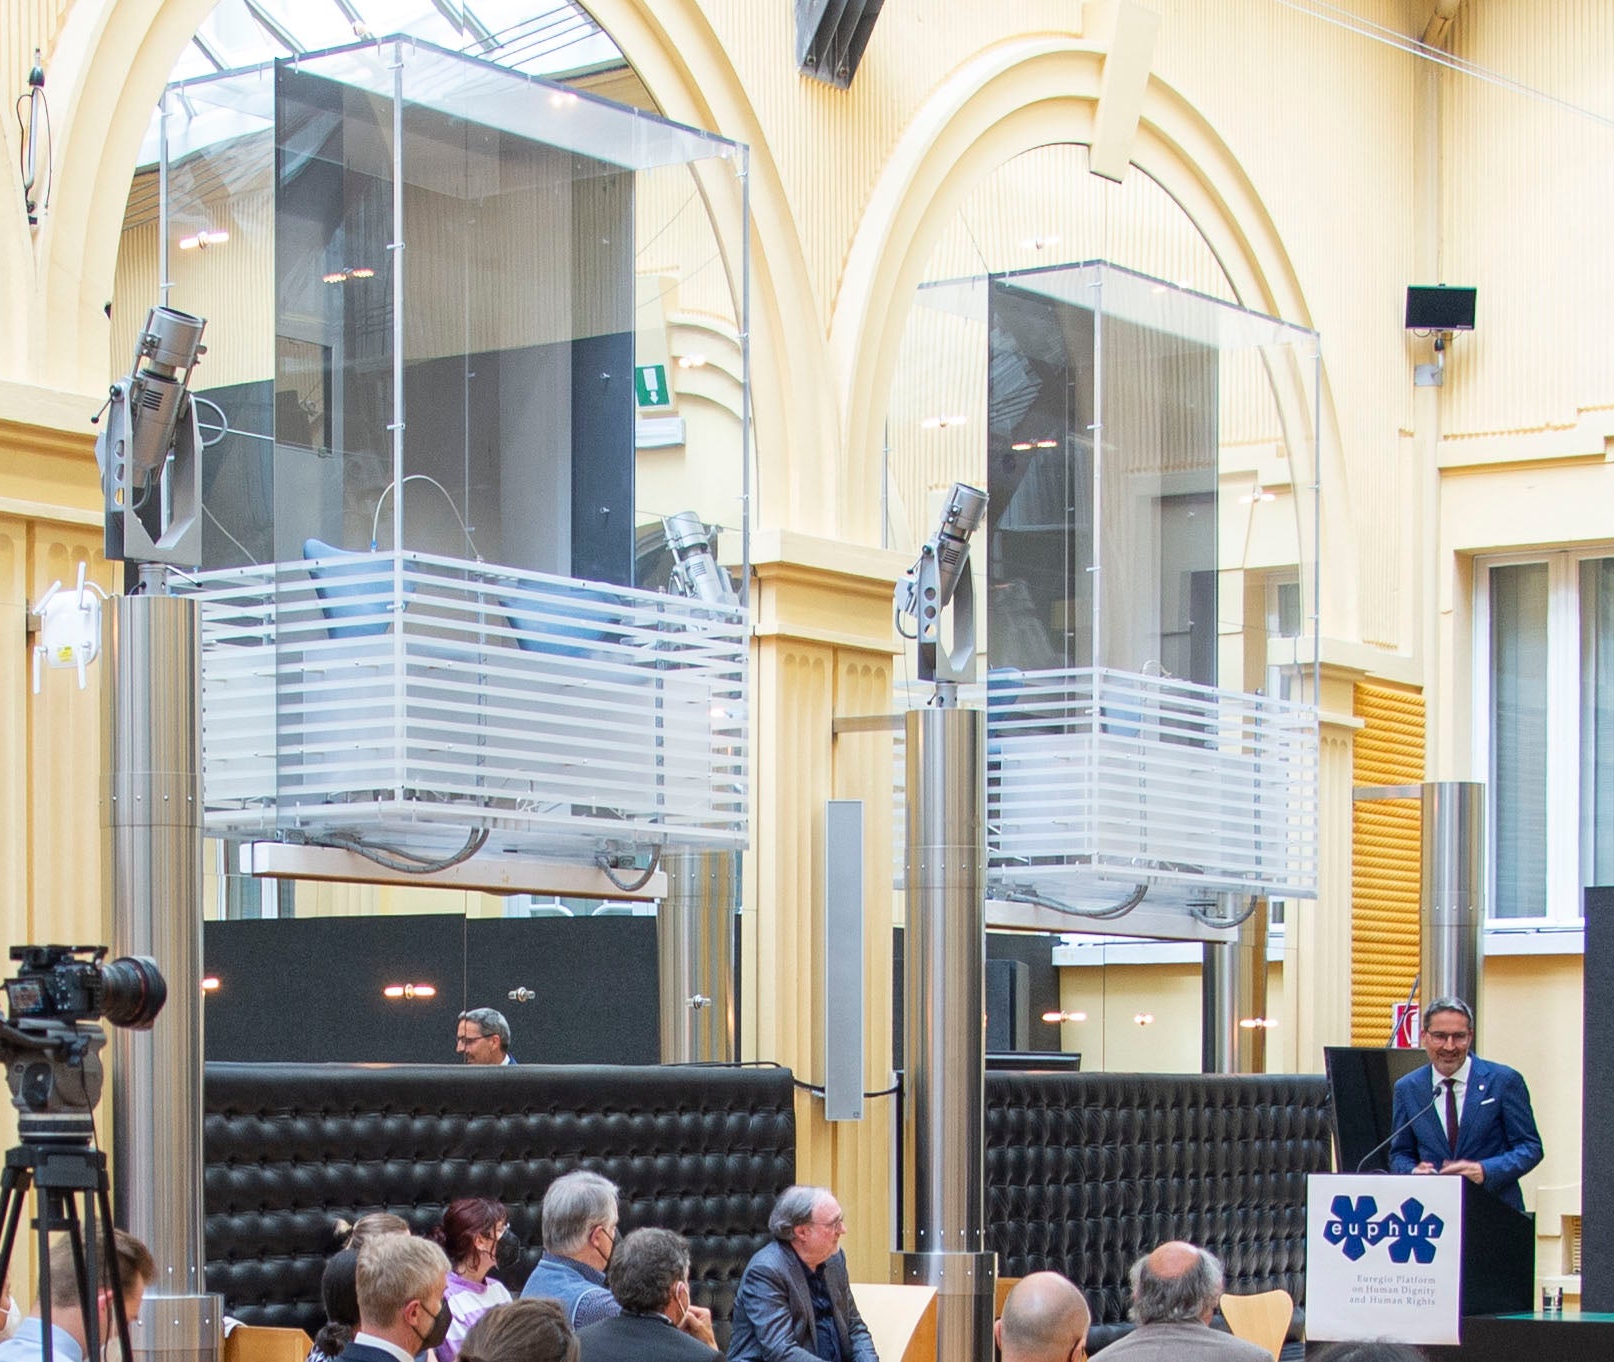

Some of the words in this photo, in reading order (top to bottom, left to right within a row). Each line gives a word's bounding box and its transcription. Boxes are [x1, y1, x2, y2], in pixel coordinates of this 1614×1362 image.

[1331, 1220, 1435, 1239] euphur
[1356, 1274, 1394, 1284] Euregio
[1396, 1275, 1436, 1284] Platform
[1352, 1286, 1364, 1294] on
[1365, 1285, 1399, 1294] Human
[1401, 1286, 1436, 1297] Dignity
[1349, 1295, 1366, 1304] and
[1369, 1295, 1403, 1304] Human
[1406, 1296, 1436, 1306] Rights
